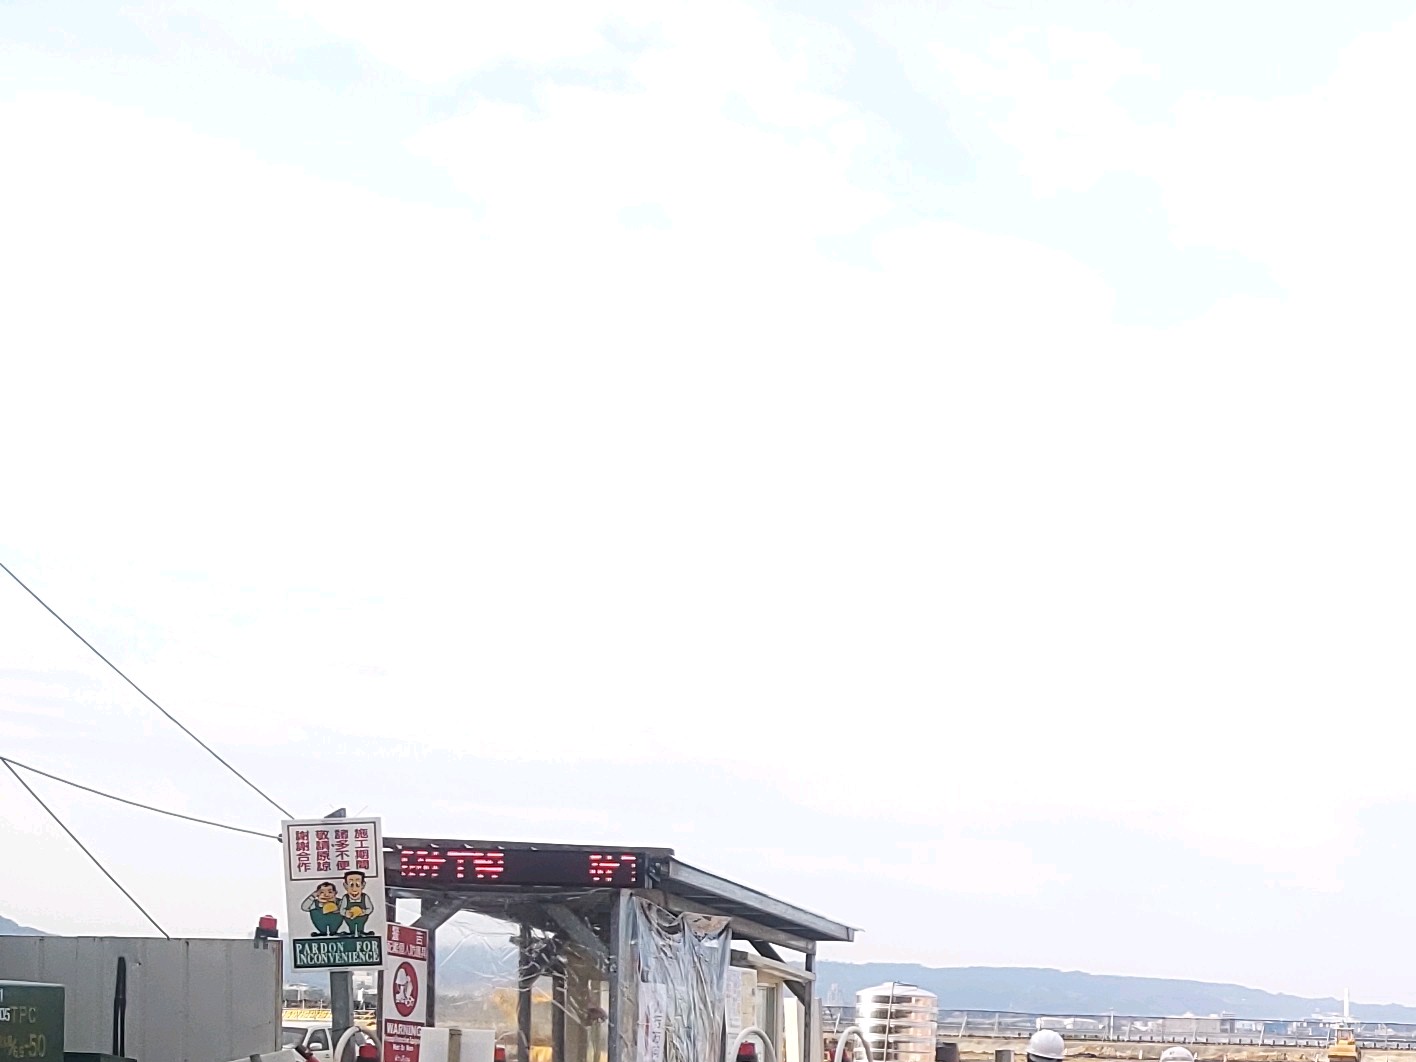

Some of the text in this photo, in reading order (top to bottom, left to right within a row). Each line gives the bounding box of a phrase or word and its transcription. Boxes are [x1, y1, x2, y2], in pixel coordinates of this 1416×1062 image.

[295, 830, 311, 873] 謝謝合作
[315, 830, 331, 872] 敬請原諒
[335, 829, 350, 871] 諸多不便
[354, 828, 370, 870] 施工期間
[295, 940, 379, 955] PARDON FOR
[296, 951, 379, 965] INCONVENIENCE
